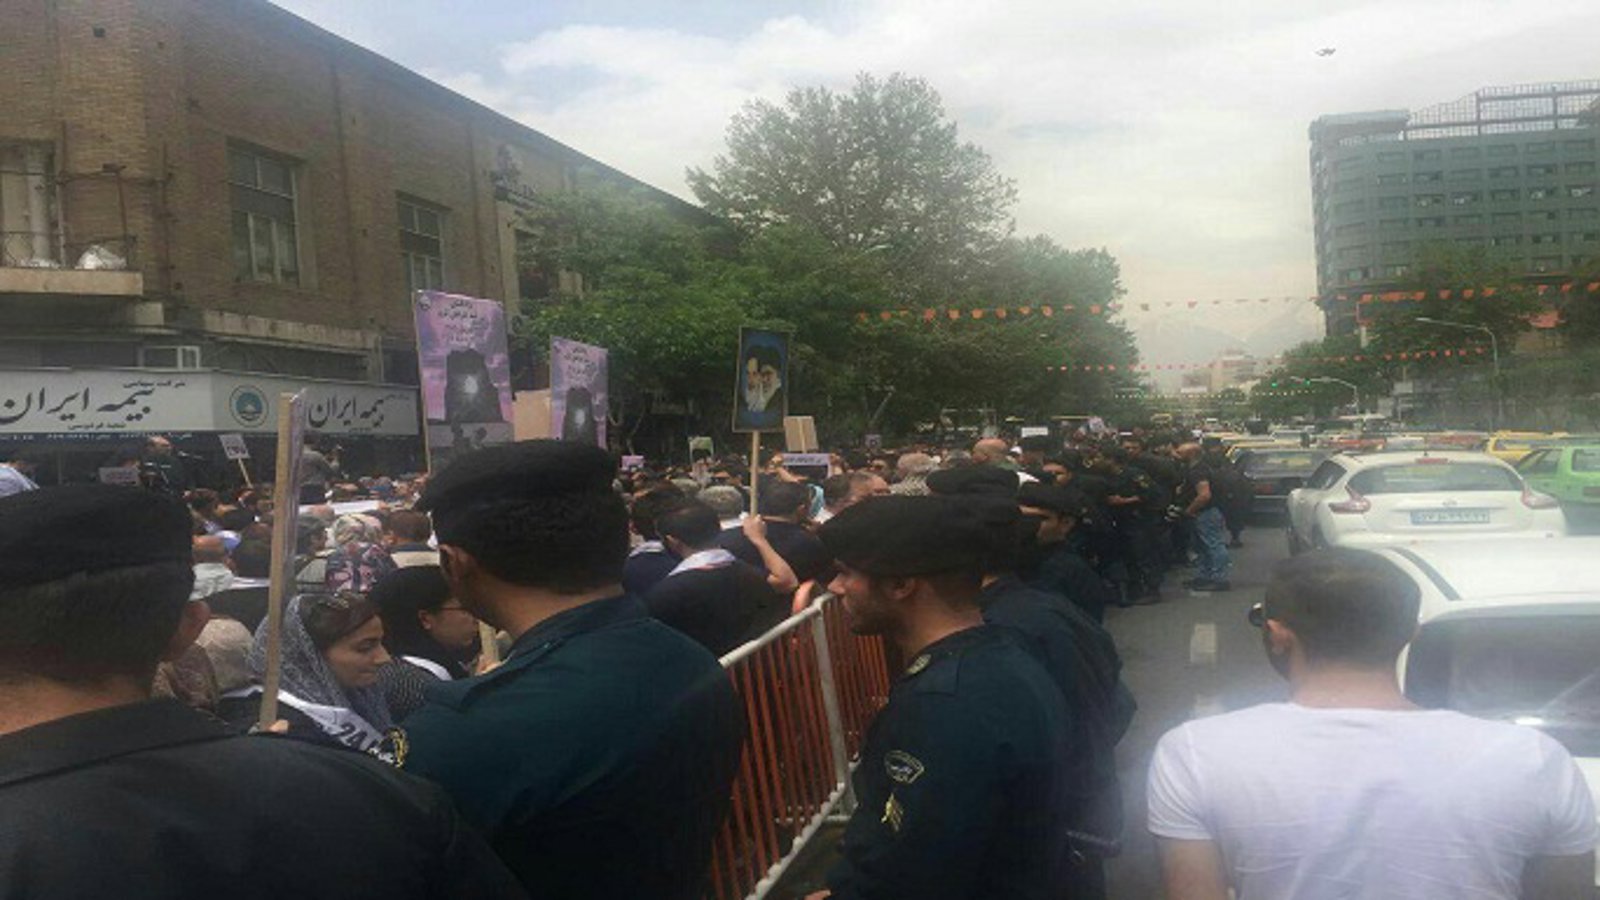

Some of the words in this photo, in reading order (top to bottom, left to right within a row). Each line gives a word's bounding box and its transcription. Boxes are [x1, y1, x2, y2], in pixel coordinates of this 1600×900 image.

[0, 387, 91, 426] ایران
[97, 388, 155, 422] بیمه
[308, 395, 356, 428] ایران
[359, 398, 385, 428] بیمه
